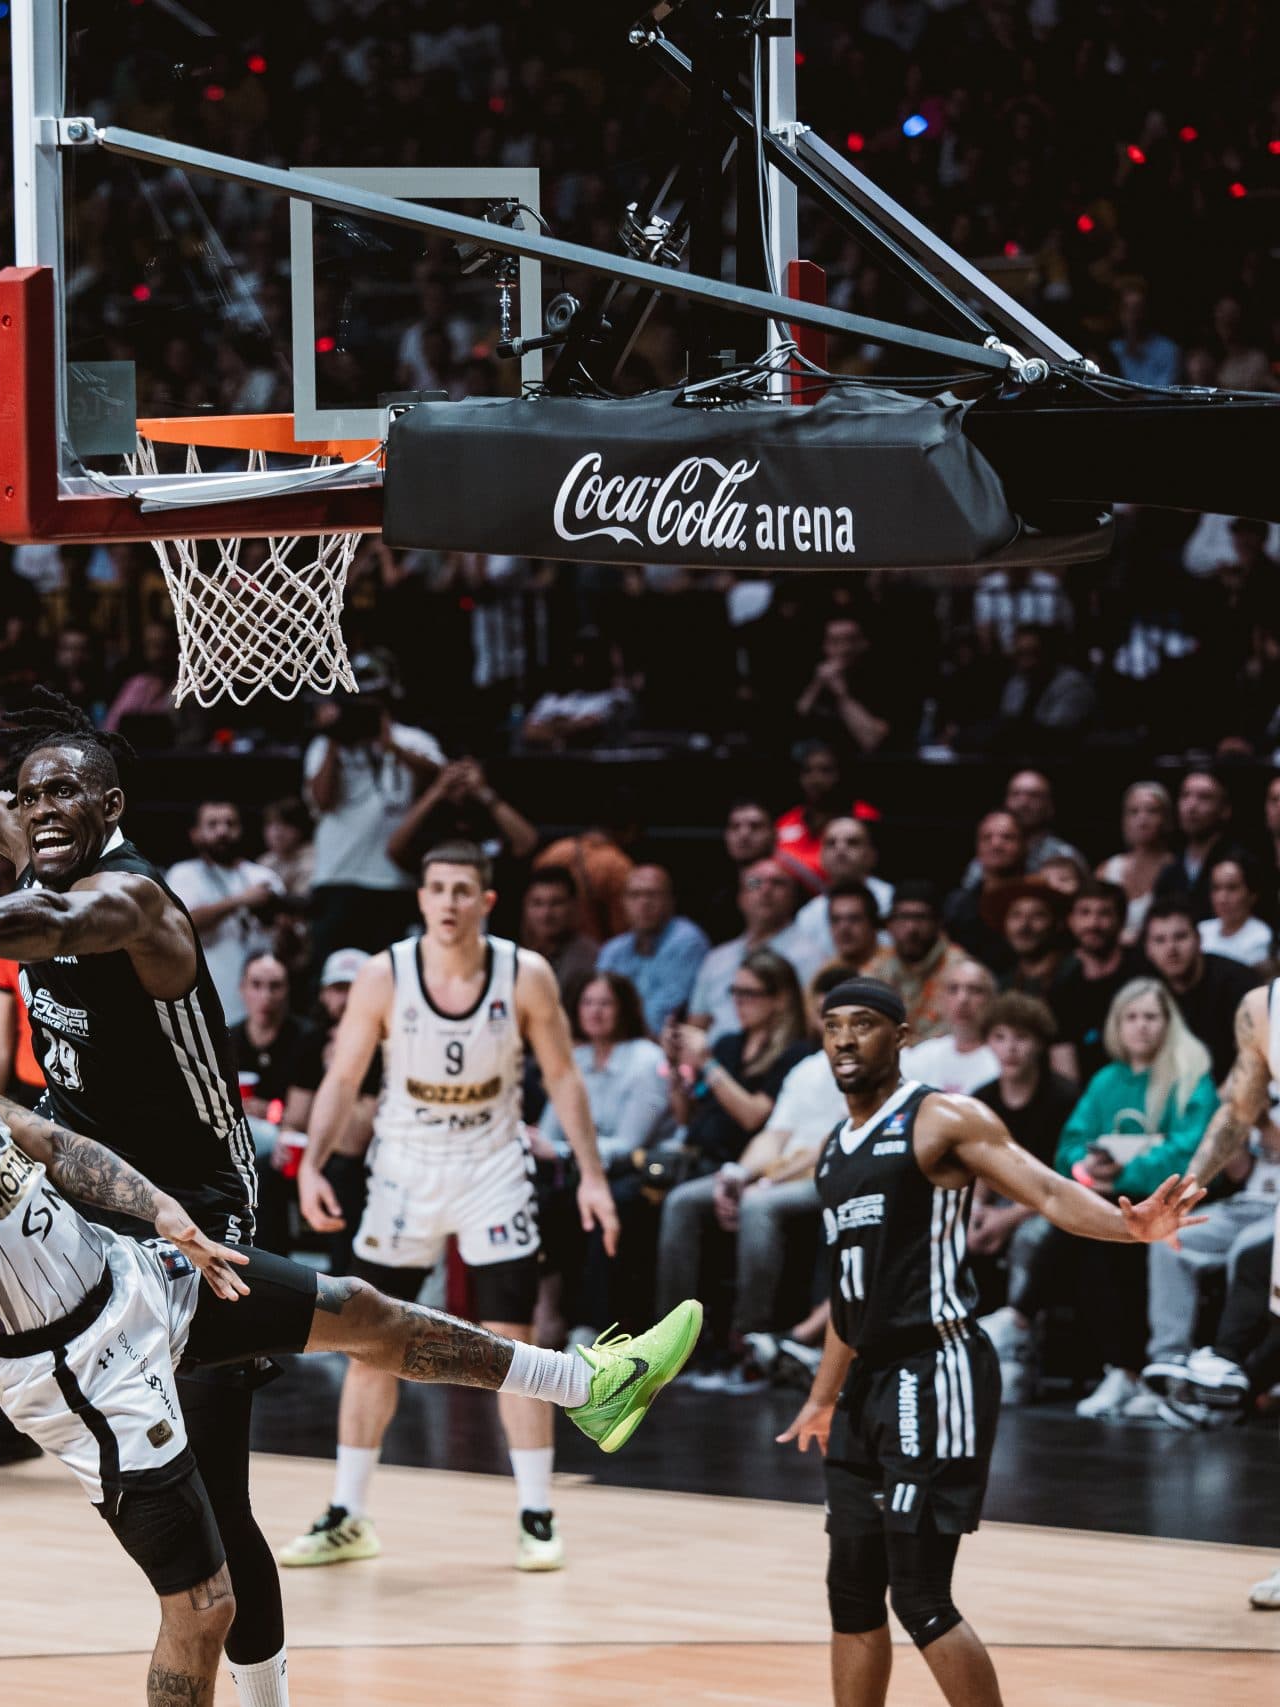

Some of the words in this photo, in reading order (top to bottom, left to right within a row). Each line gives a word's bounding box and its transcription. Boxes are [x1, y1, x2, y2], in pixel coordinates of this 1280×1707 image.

[554, 452, 760, 551] Coca-Cola
[756, 504, 856, 553] arena
[32, 1009, 90, 1037] BASKETBALL
[41, 1027, 85, 1092] 29
[445, 1041, 464, 1076] 9
[512, 1211, 532, 1246] 9
[840, 1246, 865, 1302] 11
[898, 1368, 920, 1458] SUBWAY
[891, 1482, 917, 1513] 11
